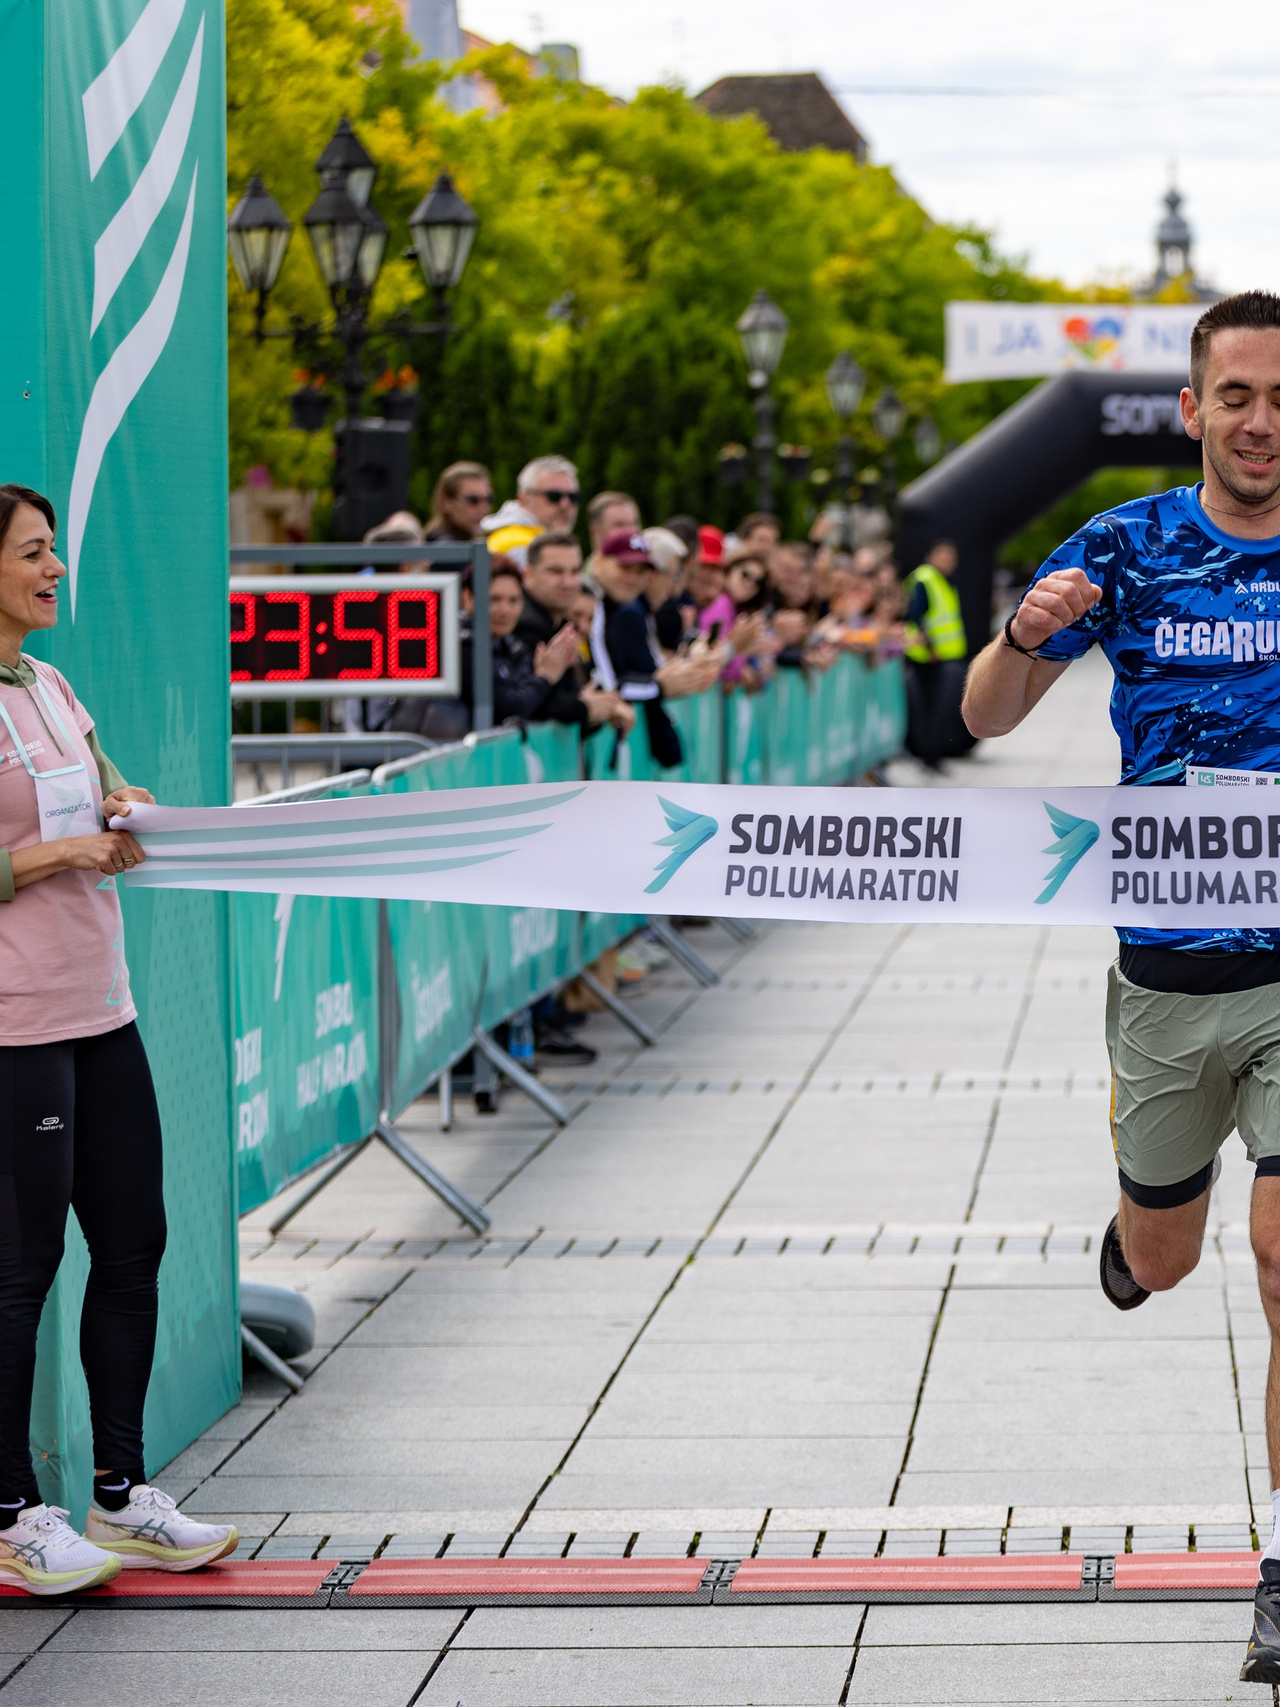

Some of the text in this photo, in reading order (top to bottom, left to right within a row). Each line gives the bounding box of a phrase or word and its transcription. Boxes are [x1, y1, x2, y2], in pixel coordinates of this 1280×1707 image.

[993, 319, 1044, 356] JA
[1215, 774, 1250, 782] SOMBORSKI
[45, 802, 91, 818] ORGANIZATOR
[729, 813, 962, 859] SOMBORSKI
[724, 864, 959, 902] POLUMARATON
